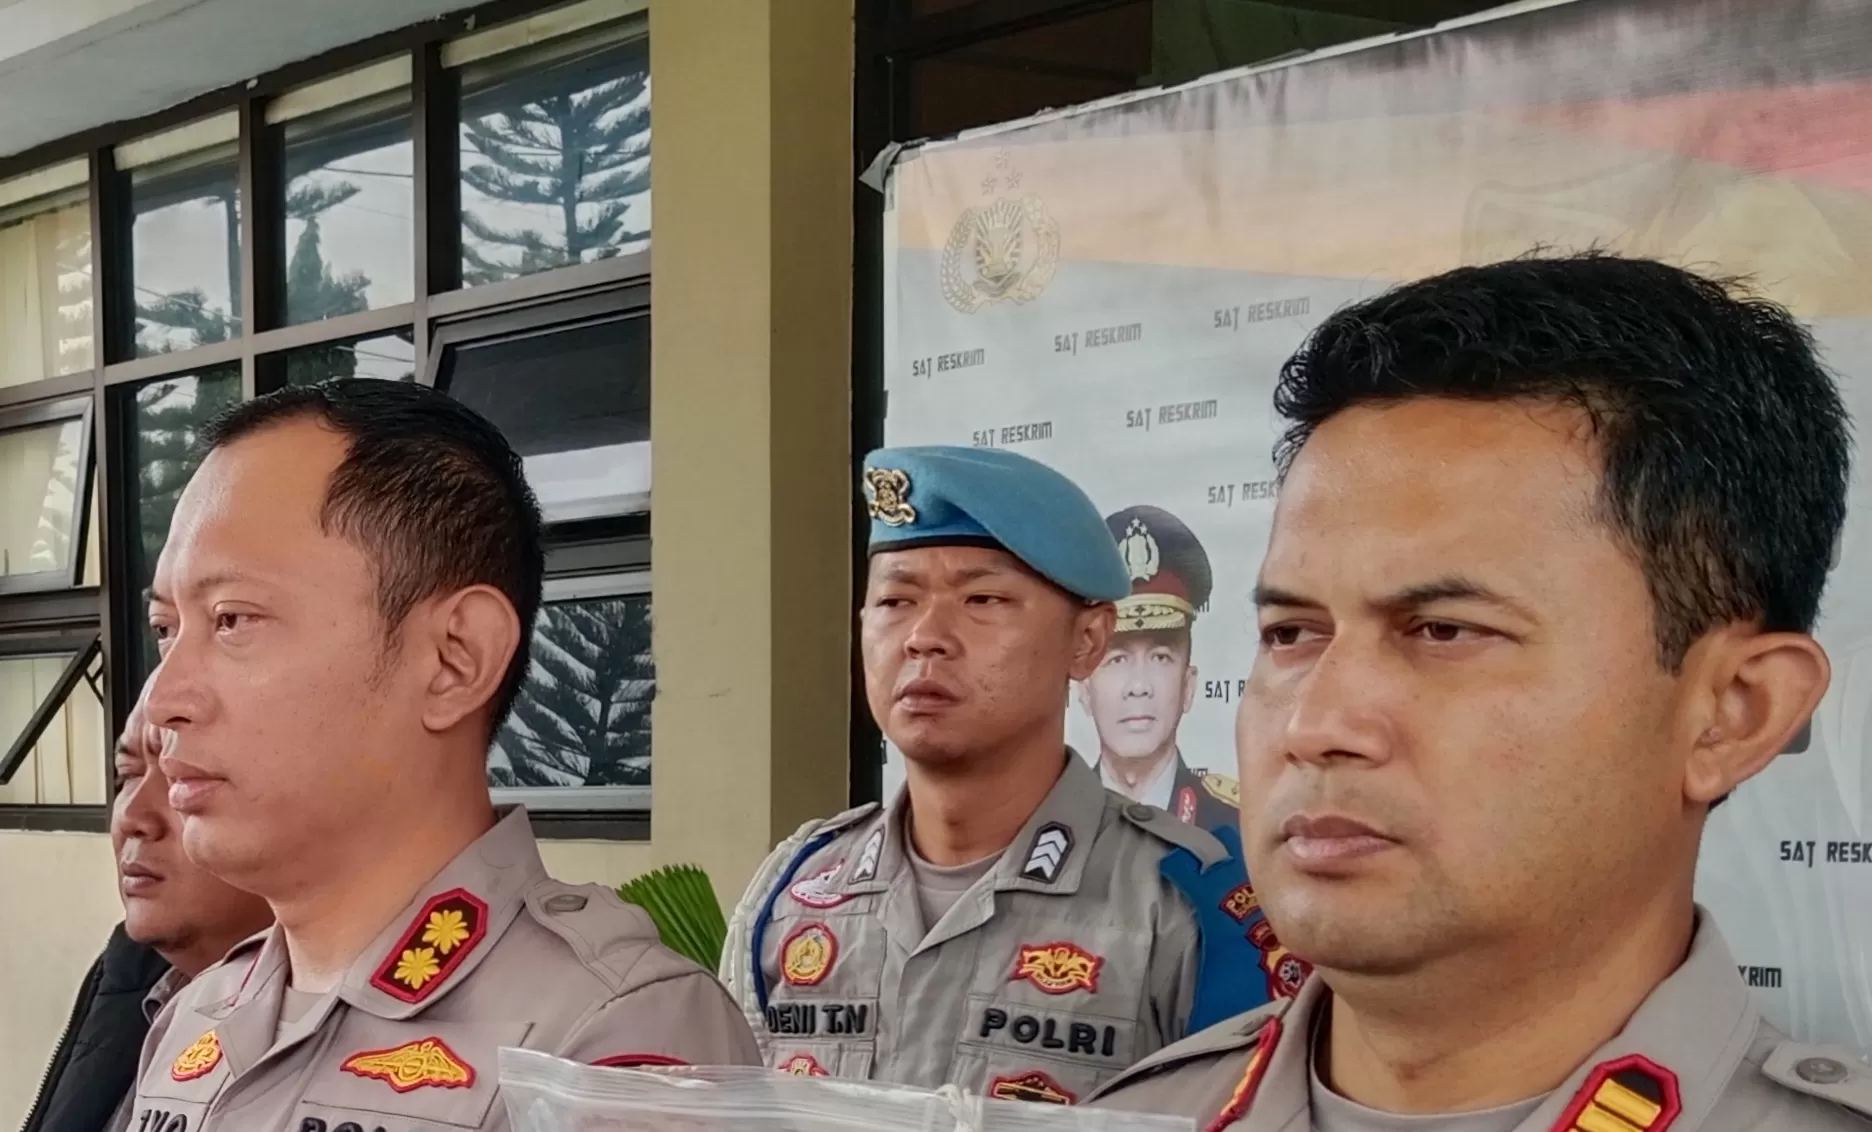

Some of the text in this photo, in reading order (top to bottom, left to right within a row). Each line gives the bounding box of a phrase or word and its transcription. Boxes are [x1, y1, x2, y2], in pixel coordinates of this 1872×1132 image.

[1213, 296, 1312, 333] SAT RESKRIM
[1054, 322, 1142, 357] SAT RESKRIM
[912, 348, 985, 380] SAT RESKRIM
[1126, 399, 1218, 432] SAT RESKRIM
[972, 421, 1053, 448] SAT RESKRIM
[1207, 483, 1235, 509] SAT
[1204, 679, 1231, 704] SAT
[1779, 840, 1816, 868] SAT
[767, 1004, 816, 1035] DENI
[979, 1007, 1116, 1057] POLRI
